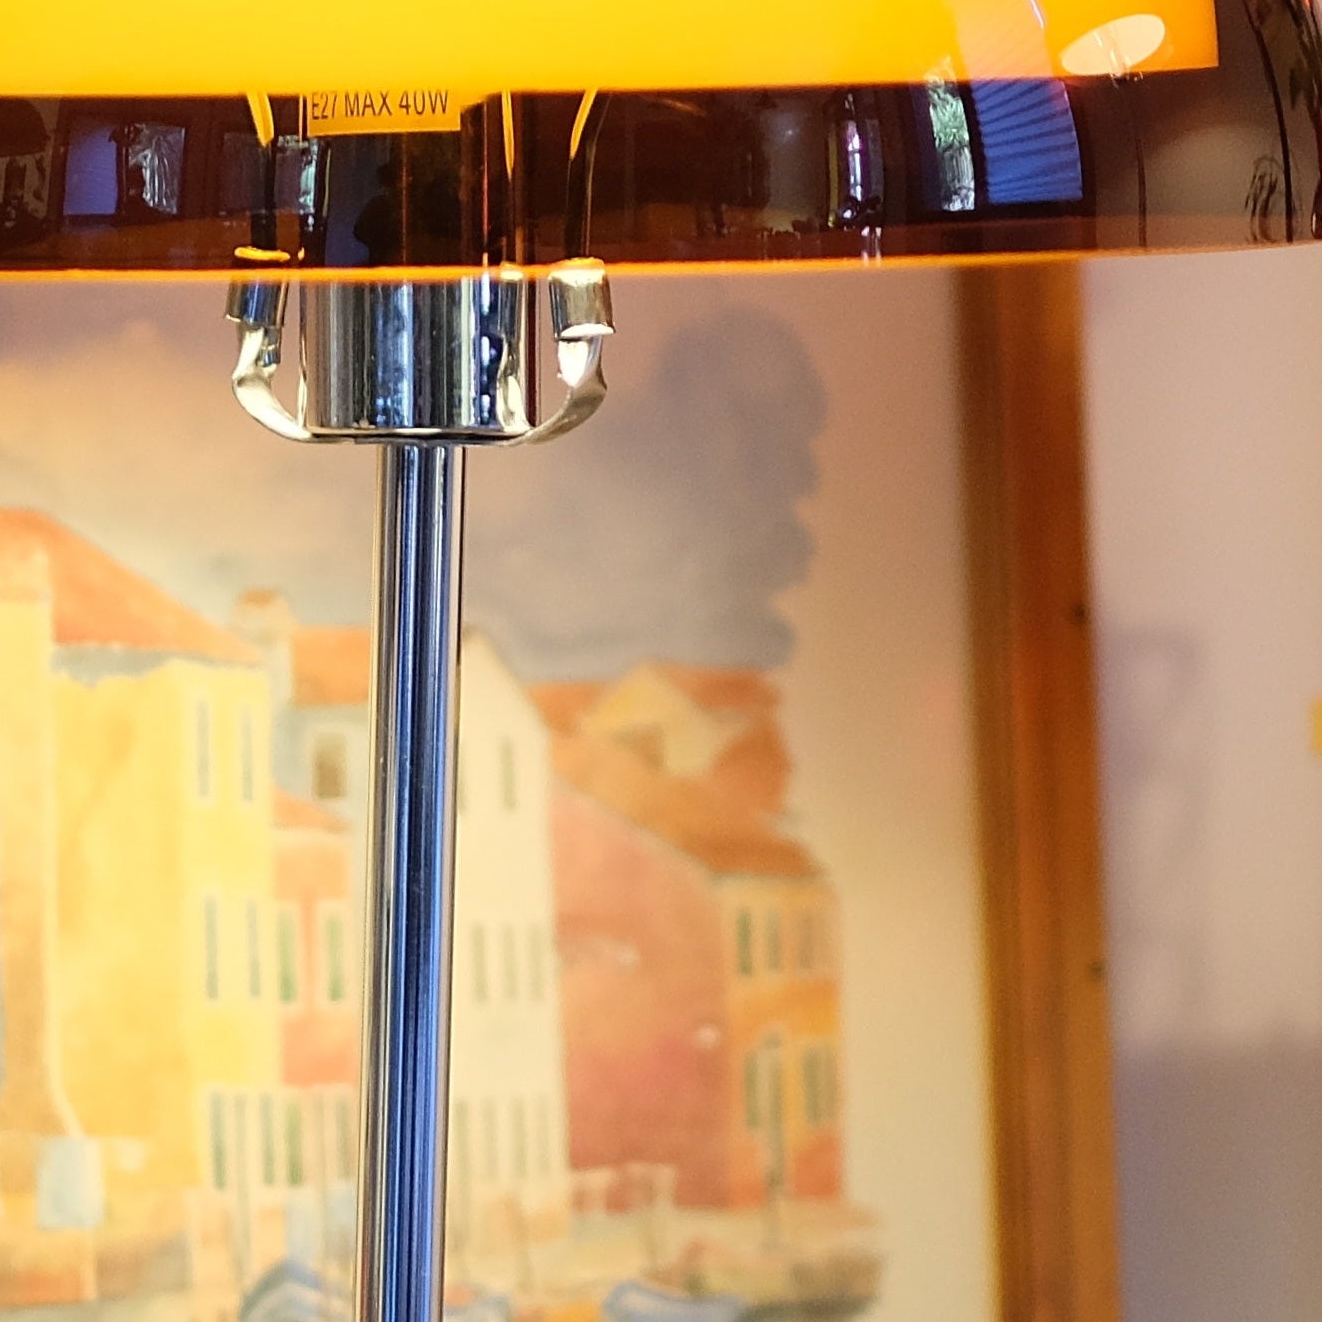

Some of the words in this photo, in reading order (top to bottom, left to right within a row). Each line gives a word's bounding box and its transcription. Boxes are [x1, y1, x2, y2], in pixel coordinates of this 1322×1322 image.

[311, 89, 338, 120] E27
[344, 89, 393, 117] MAX
[398, 88, 449, 116] 40W
